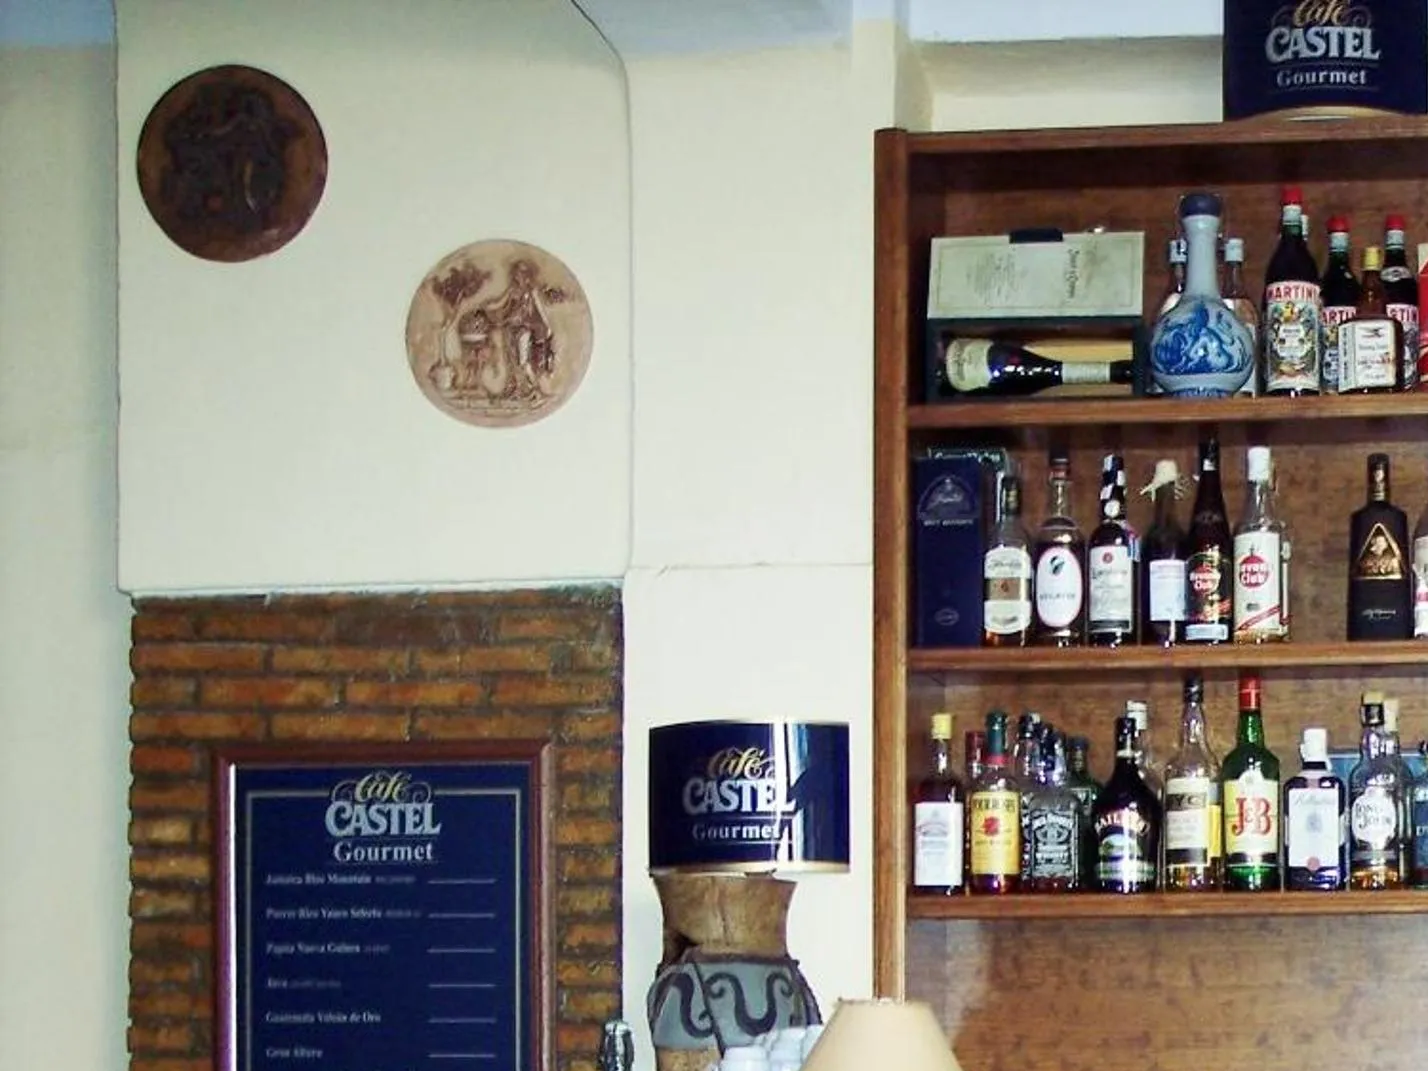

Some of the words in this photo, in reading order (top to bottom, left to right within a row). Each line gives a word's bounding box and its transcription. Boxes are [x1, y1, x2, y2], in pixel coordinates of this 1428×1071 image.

[1265, 26, 1382, 63] CASTEL
[1276, 69, 1367, 88] Gourmet
[707, 747, 765, 779] Café
[682, 777, 797, 815] CASTEL
[324, 800, 442, 836] CASTEL
[1231, 798, 1272, 835] J&B
[333, 841, 434, 863] Gourmet
